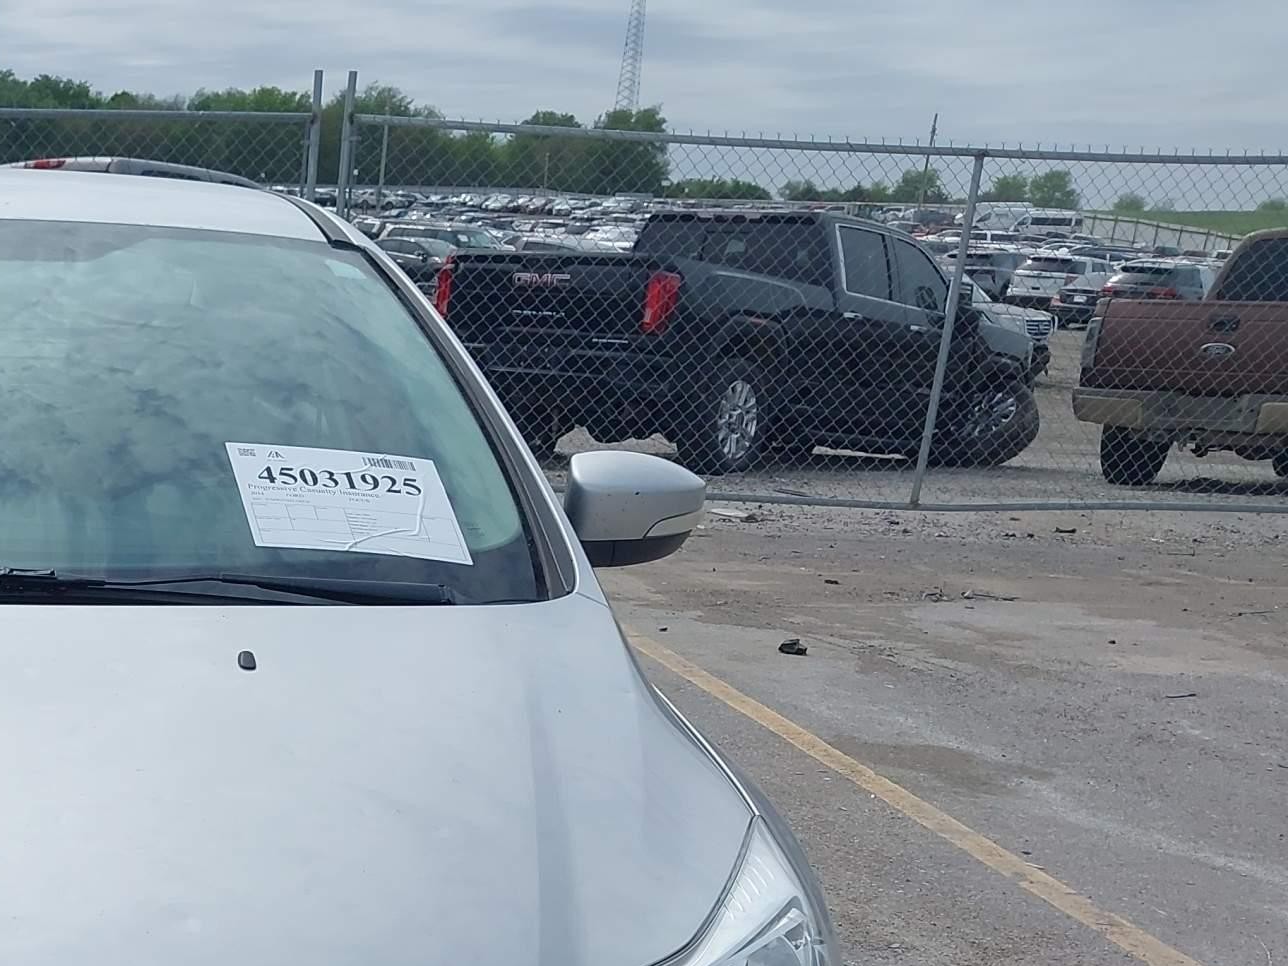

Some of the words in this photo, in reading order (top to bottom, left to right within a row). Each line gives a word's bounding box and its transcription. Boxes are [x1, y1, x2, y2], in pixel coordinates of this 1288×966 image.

[512, 272, 571, 287] GMC
[258, 465, 422, 496] 45031925
[248, 483, 298, 493] Progressive
[299, 487, 337, 496] Casualty
[339, 489, 380, 499] Insurance
